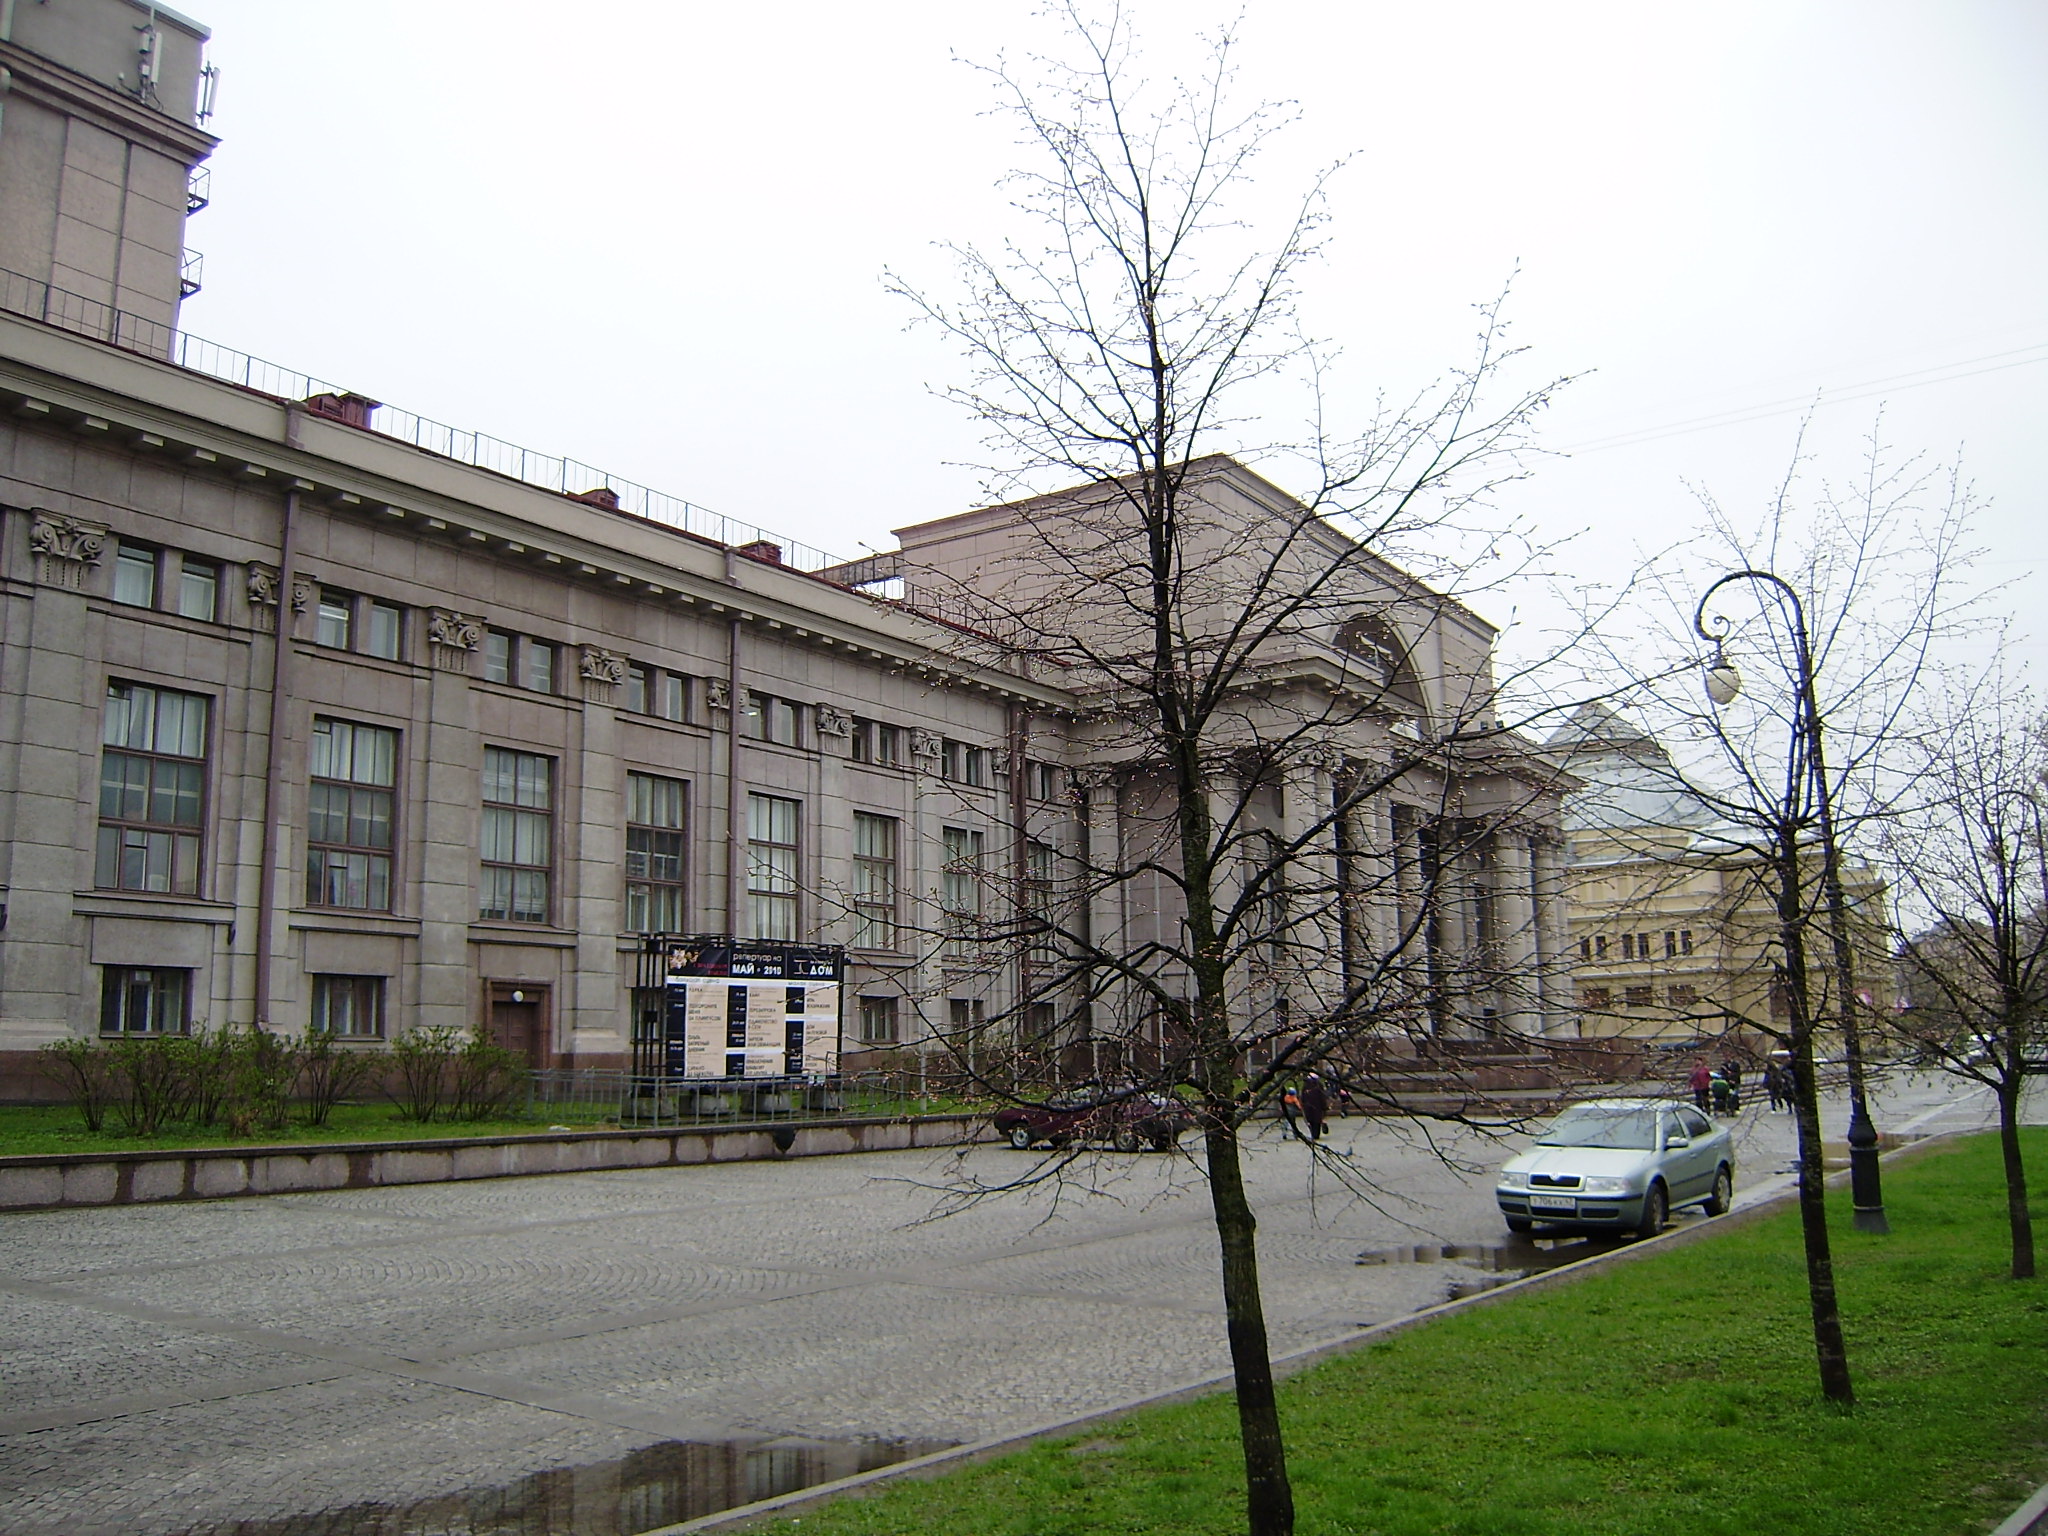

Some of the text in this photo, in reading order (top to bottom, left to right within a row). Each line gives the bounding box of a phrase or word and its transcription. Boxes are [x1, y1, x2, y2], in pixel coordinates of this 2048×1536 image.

[733, 953, 772, 963] репертуар
[732, 962, 782, 975] МАЙ 2010
[809, 965, 833, 976] ДОМ
